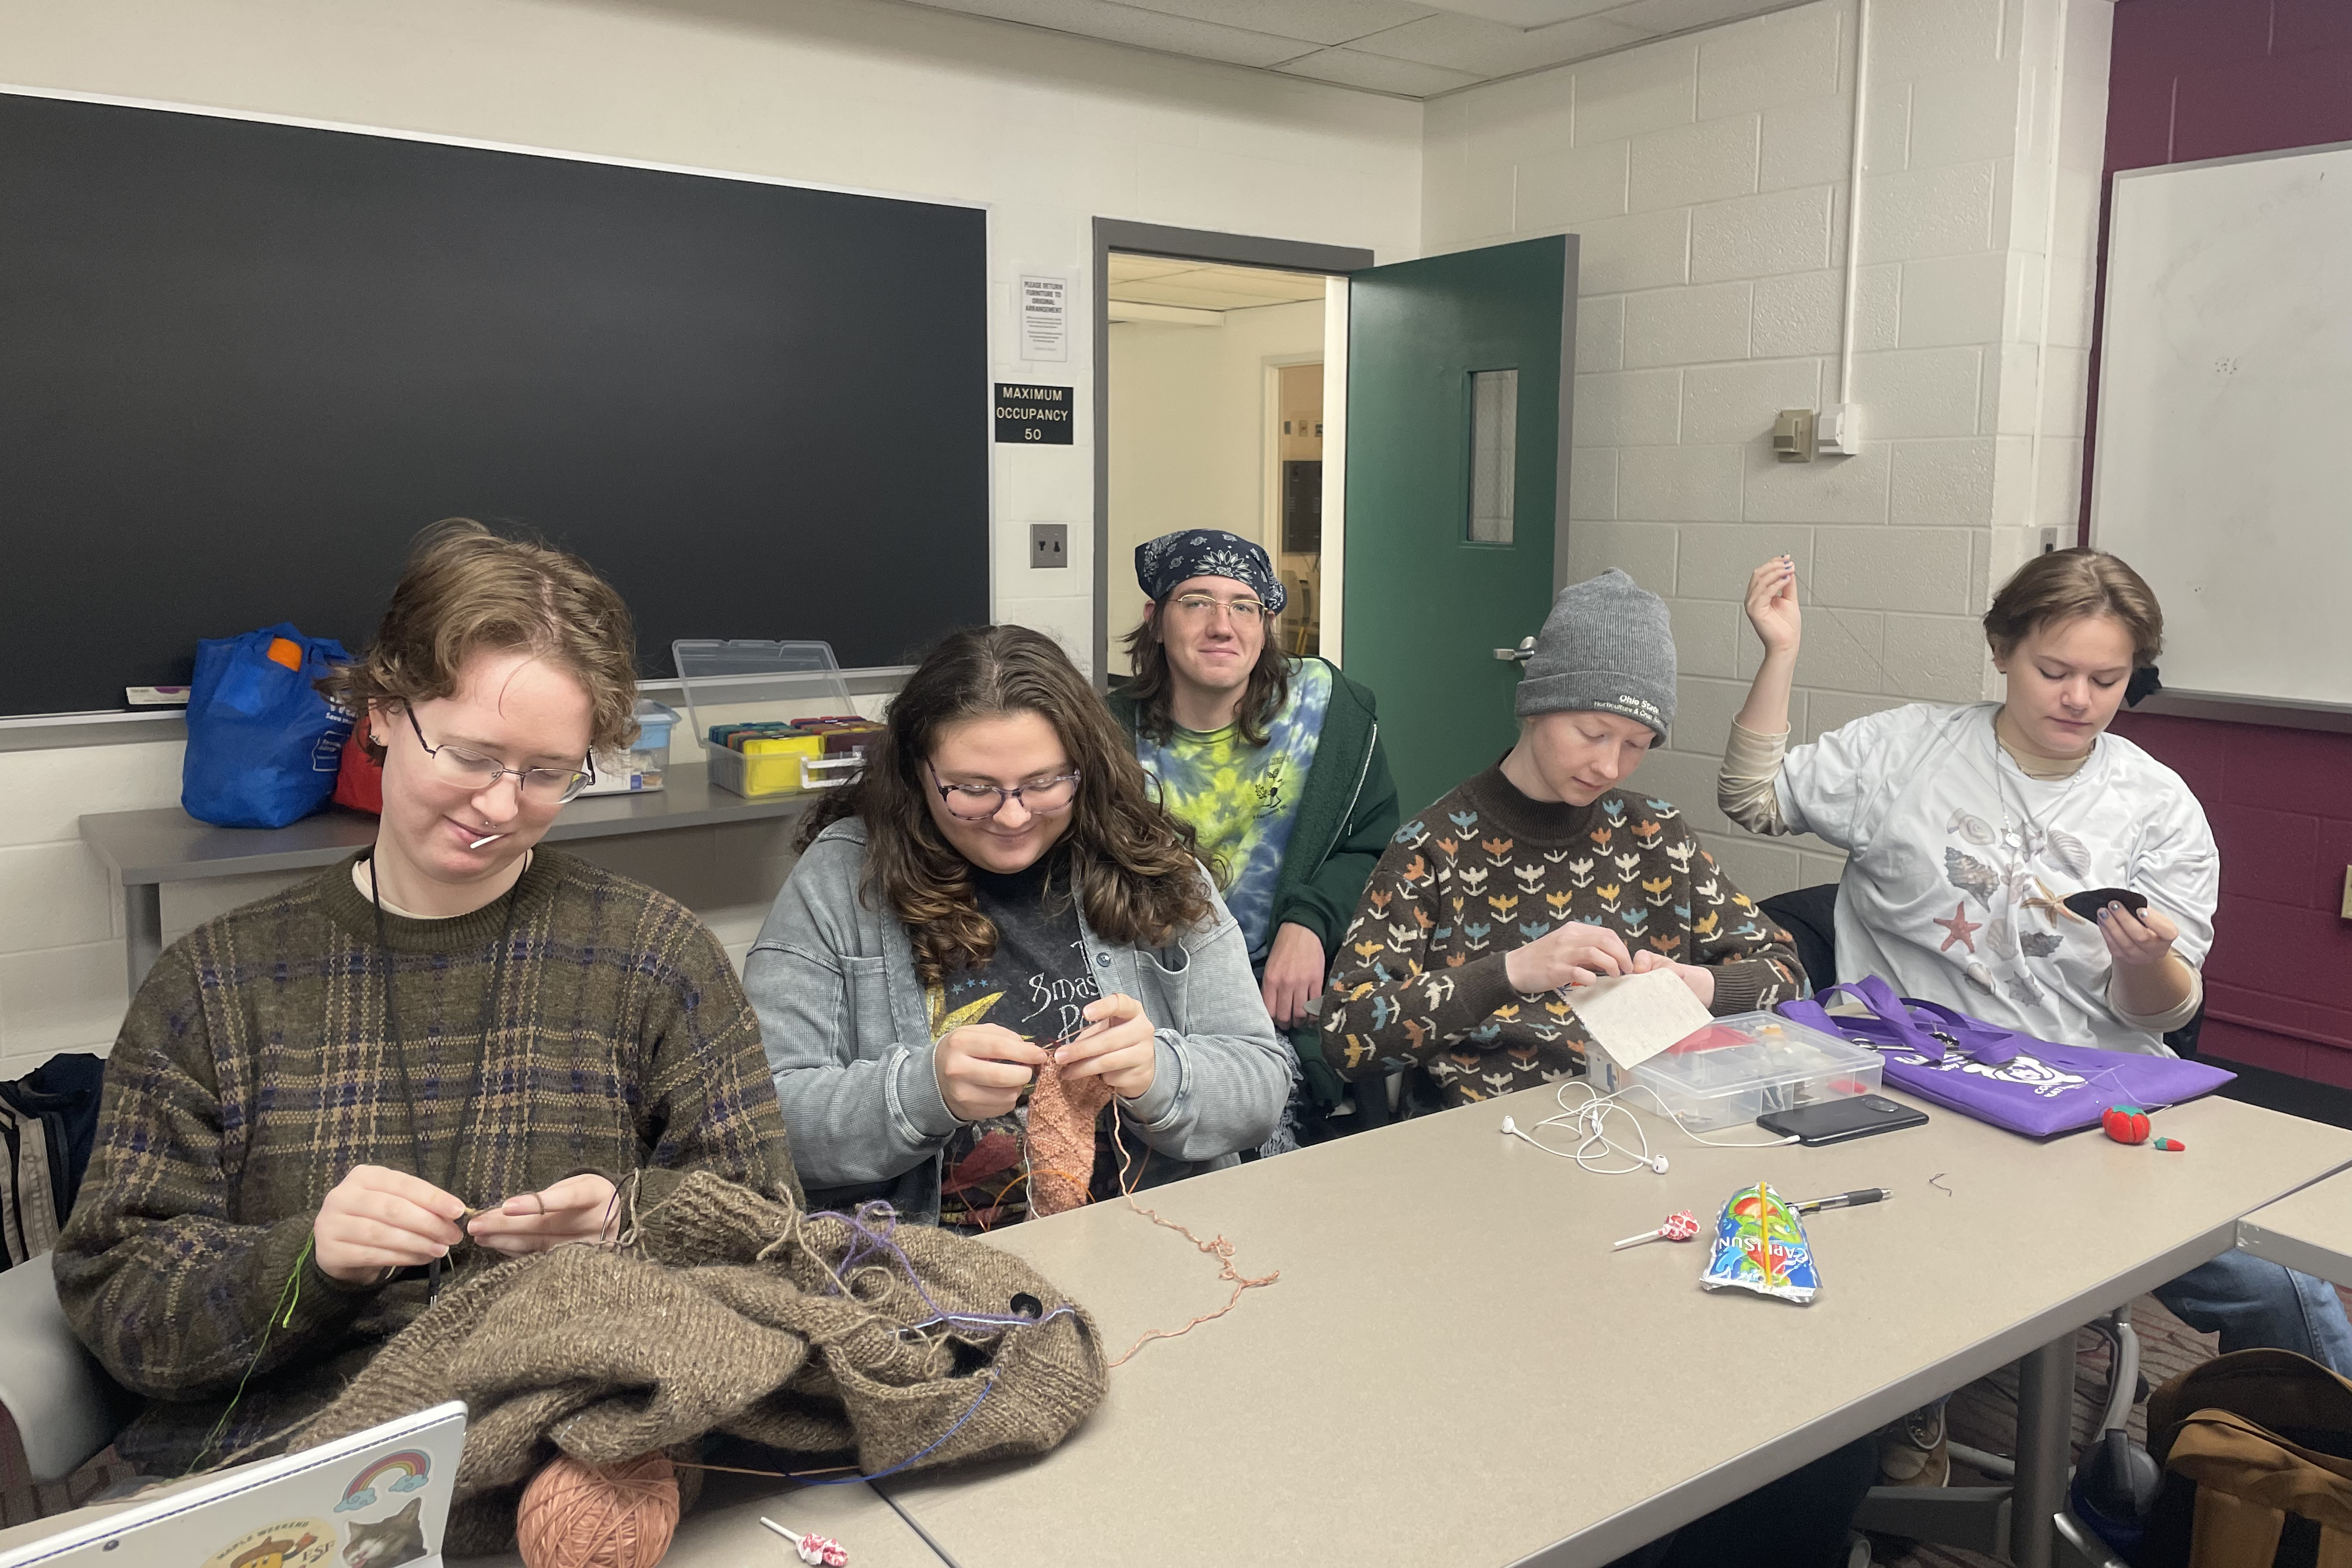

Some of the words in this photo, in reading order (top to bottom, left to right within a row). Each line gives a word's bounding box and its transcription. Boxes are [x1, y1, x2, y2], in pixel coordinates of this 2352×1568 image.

[1003, 386, 1062, 401] MAXIMUM
[996, 407, 1068, 422] OCCUPANCY
[1024, 428, 1041, 440] 50
[1619, 695, 1640, 706] Ohio
[1641, 700, 1660, 715] State
[257, 1521, 310, 1537] WEEKEND
